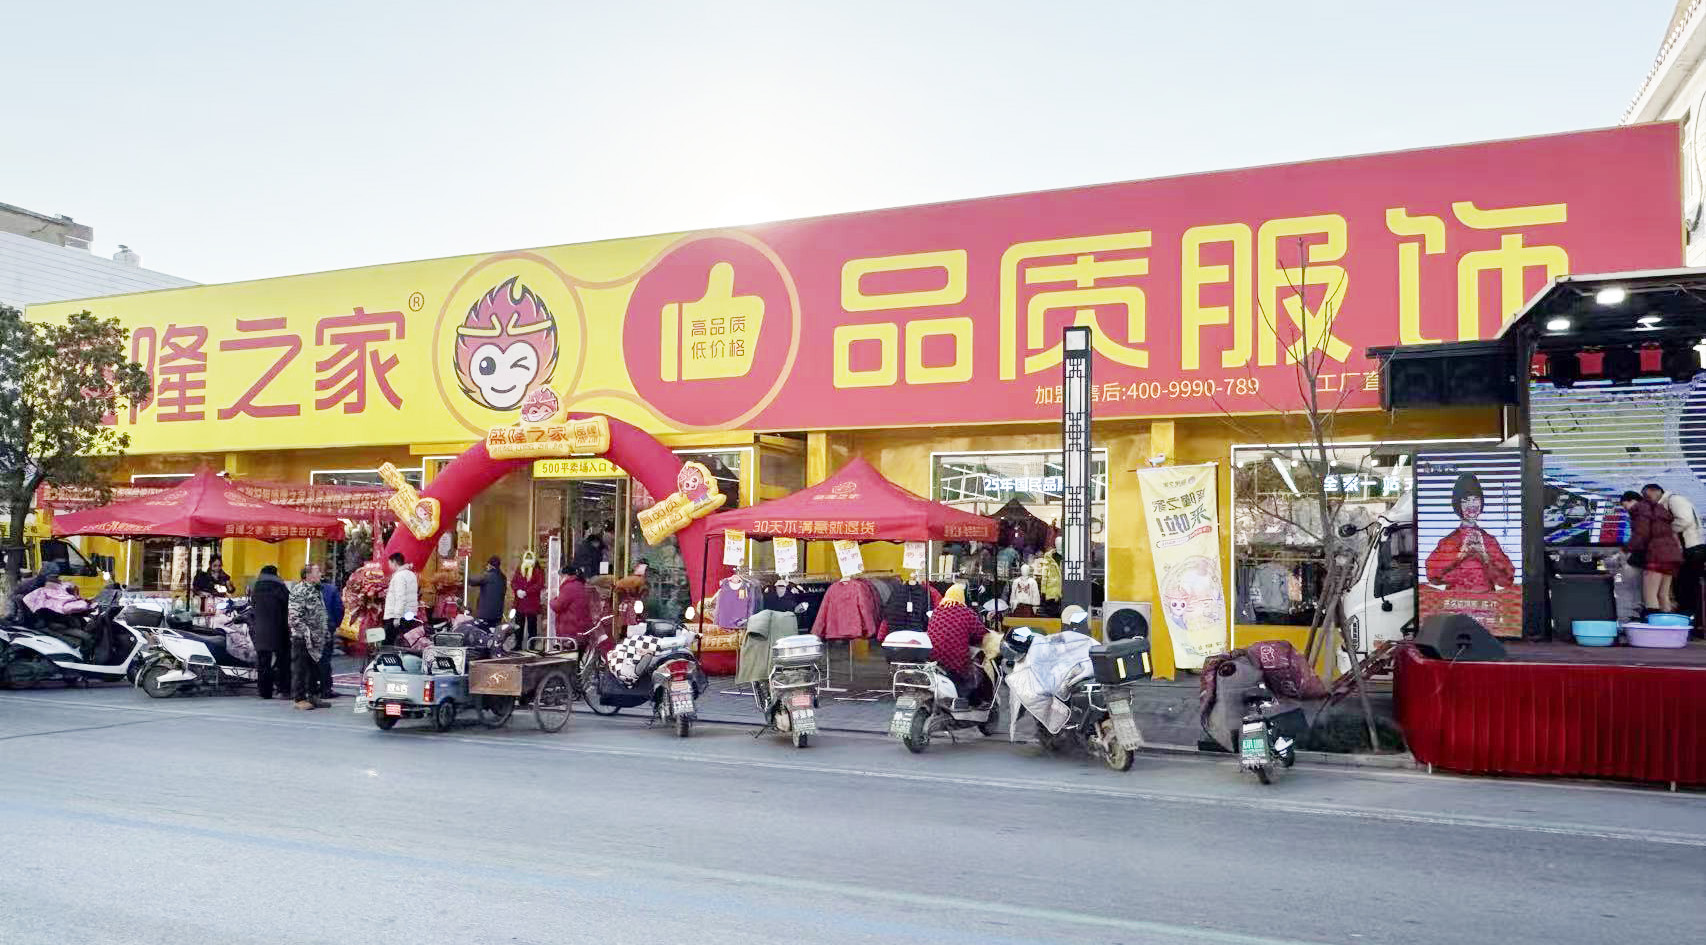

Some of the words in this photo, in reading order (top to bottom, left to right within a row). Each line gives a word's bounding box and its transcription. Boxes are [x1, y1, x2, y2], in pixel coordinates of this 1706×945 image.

[832, 200, 1569, 389] 品质服饰
[691, 315, 746, 337] 高品质
[691, 339, 745, 360] 低价格
[57, 306, 405, 426] 隆之家
[542, 462, 607, 474] 500平卖场入口
[752, 520, 875, 535] 30天不满意就退货
